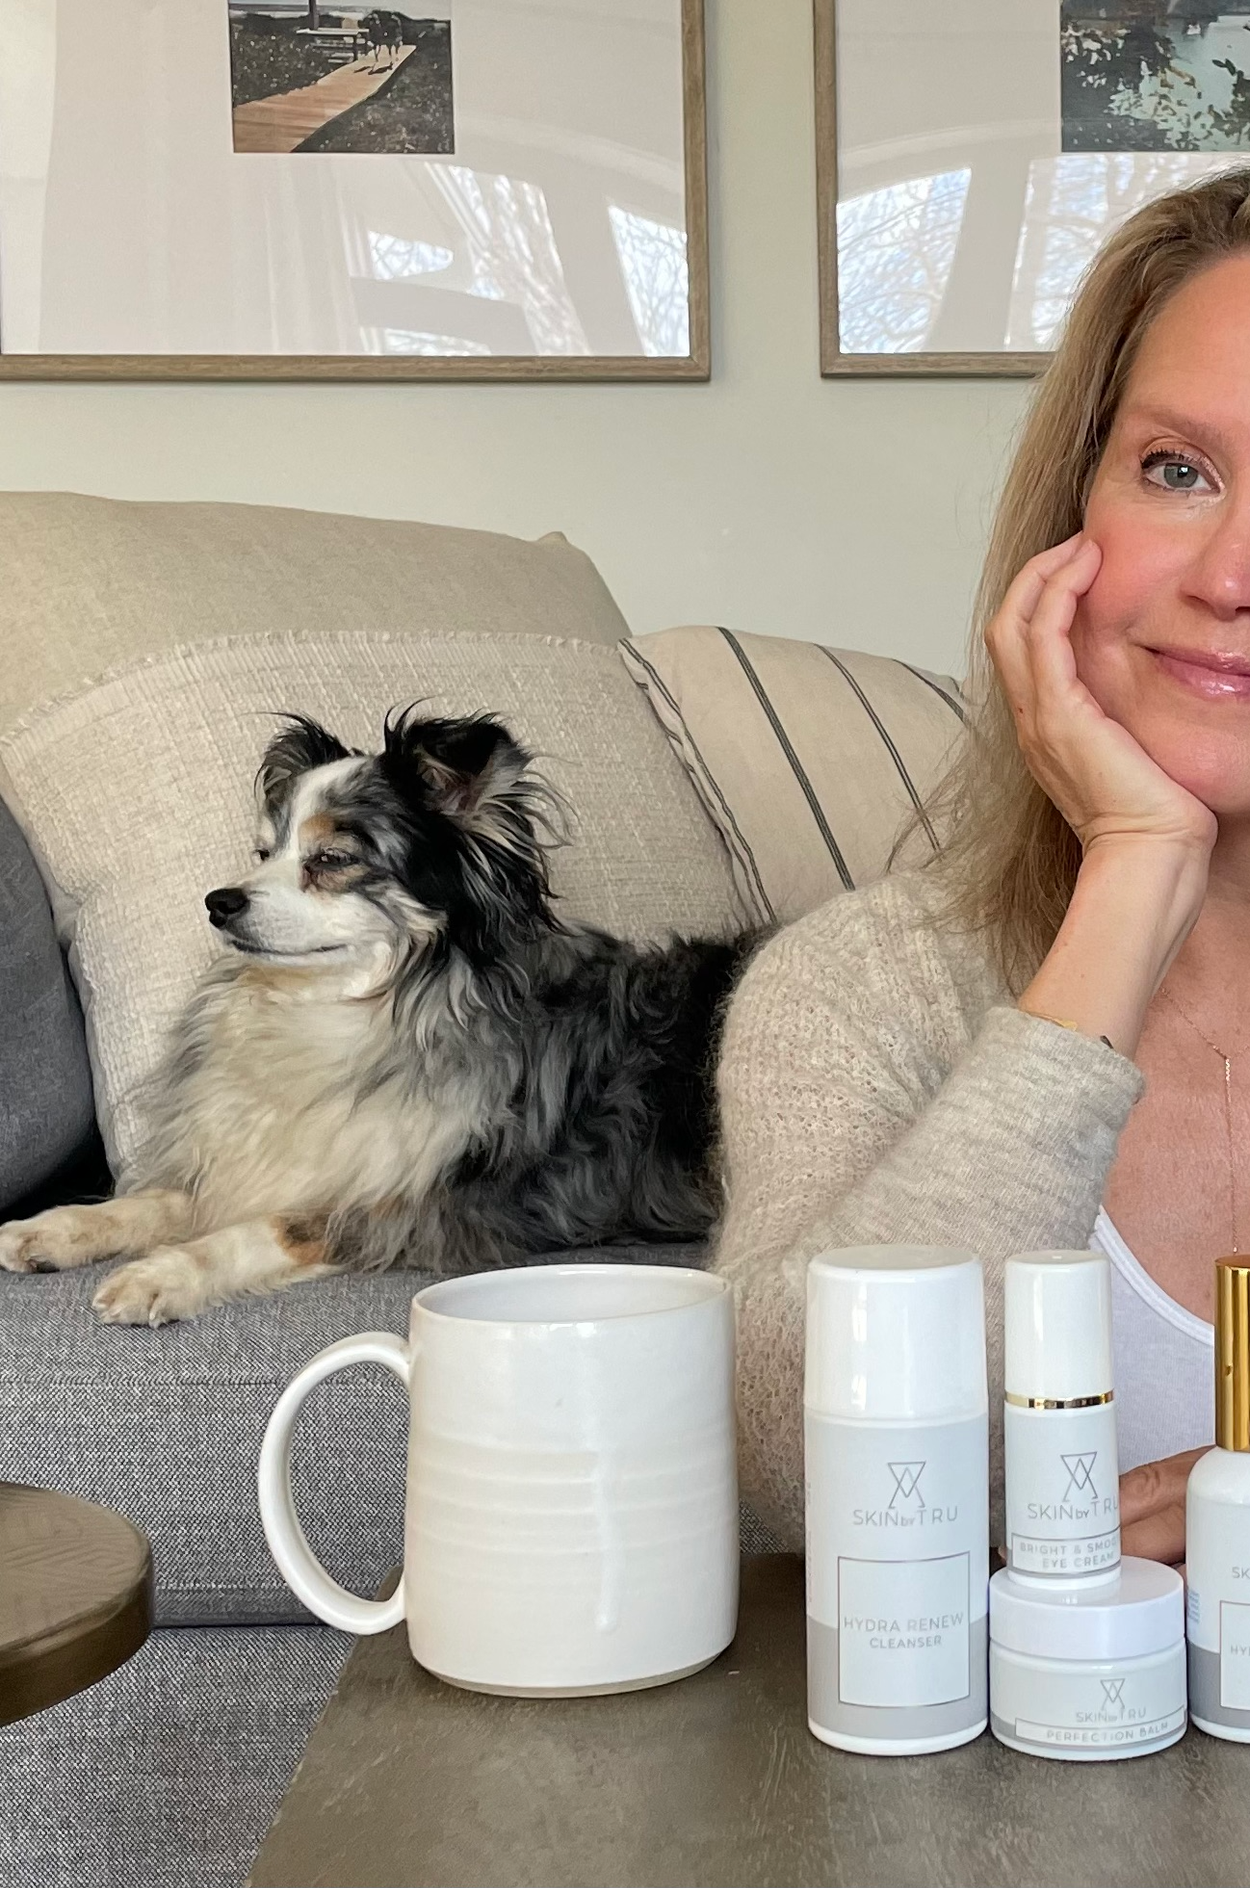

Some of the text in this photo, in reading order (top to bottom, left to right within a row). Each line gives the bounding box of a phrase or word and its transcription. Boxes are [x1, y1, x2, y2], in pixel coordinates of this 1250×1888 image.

[1020, 1542, 1067, 1556] BRIGHT
[1086, 1536, 1117, 1553] SMOO
[1042, 1551, 1115, 1569] EYE CREAM
[844, 1612, 964, 1633] HYDRA RENEW
[869, 1634, 943, 1650] CLEANSER
[1046, 1721, 1169, 1742] PERFECTION BALM
